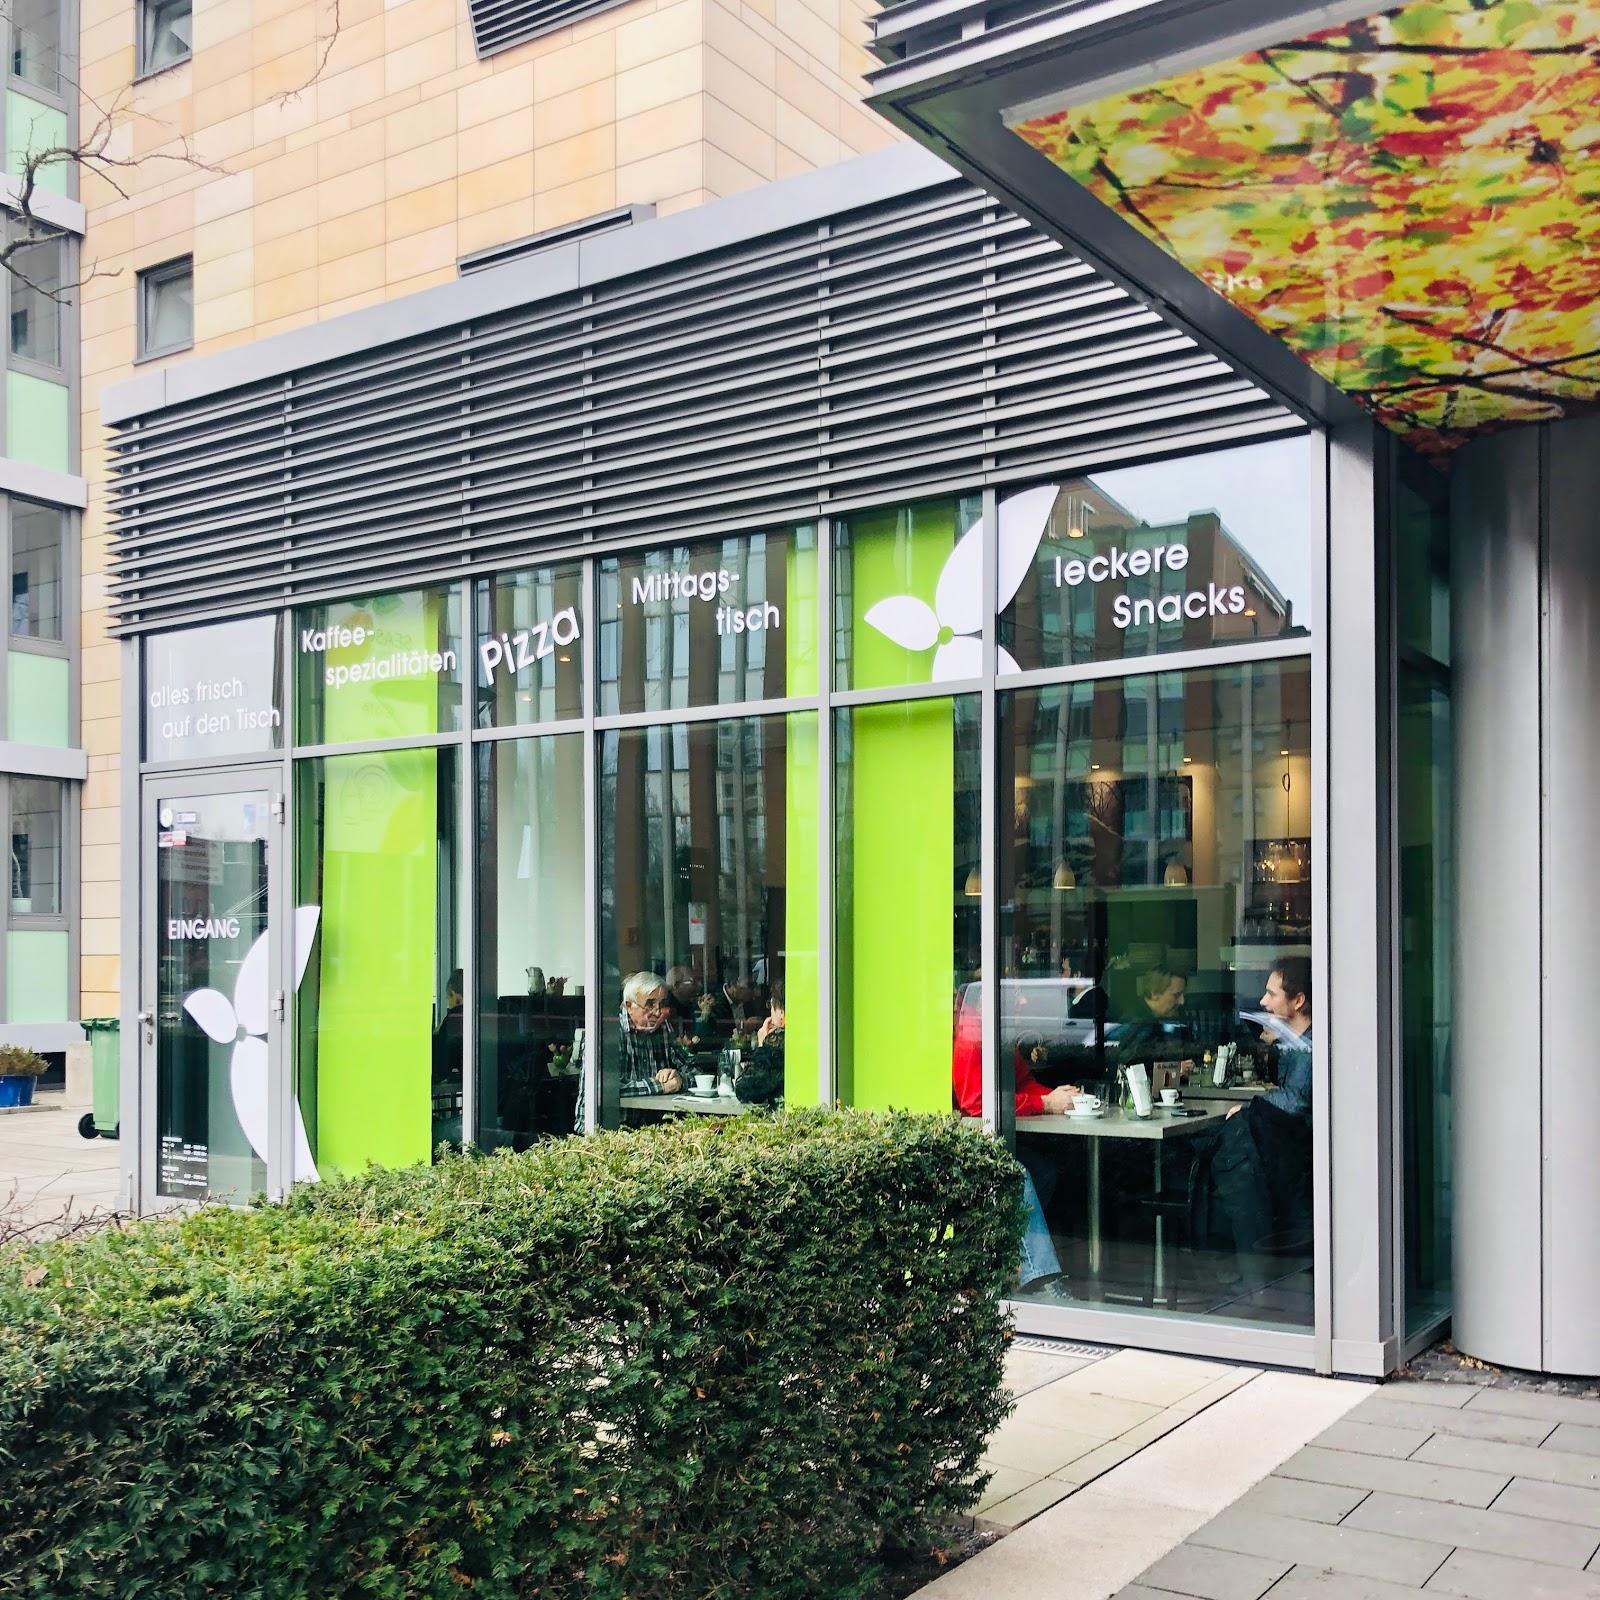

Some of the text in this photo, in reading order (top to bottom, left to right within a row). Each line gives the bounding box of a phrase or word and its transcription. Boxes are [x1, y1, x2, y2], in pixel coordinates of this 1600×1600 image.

[1055, 543, 1189, 588] leckere
[632, 568, 740, 605] Mittags-
[715, 601, 780, 636] tisch
[1112, 582, 1246, 629] Snacks
[302, 624, 374, 653] Kaffee-
[480, 606, 581, 686] Pizza
[325, 649, 457, 689] spezialitäten
[150, 676, 243, 709] alles frisch
[162, 705, 281, 739] auf den Tisch
[168, 918, 240, 940] EINGANG
